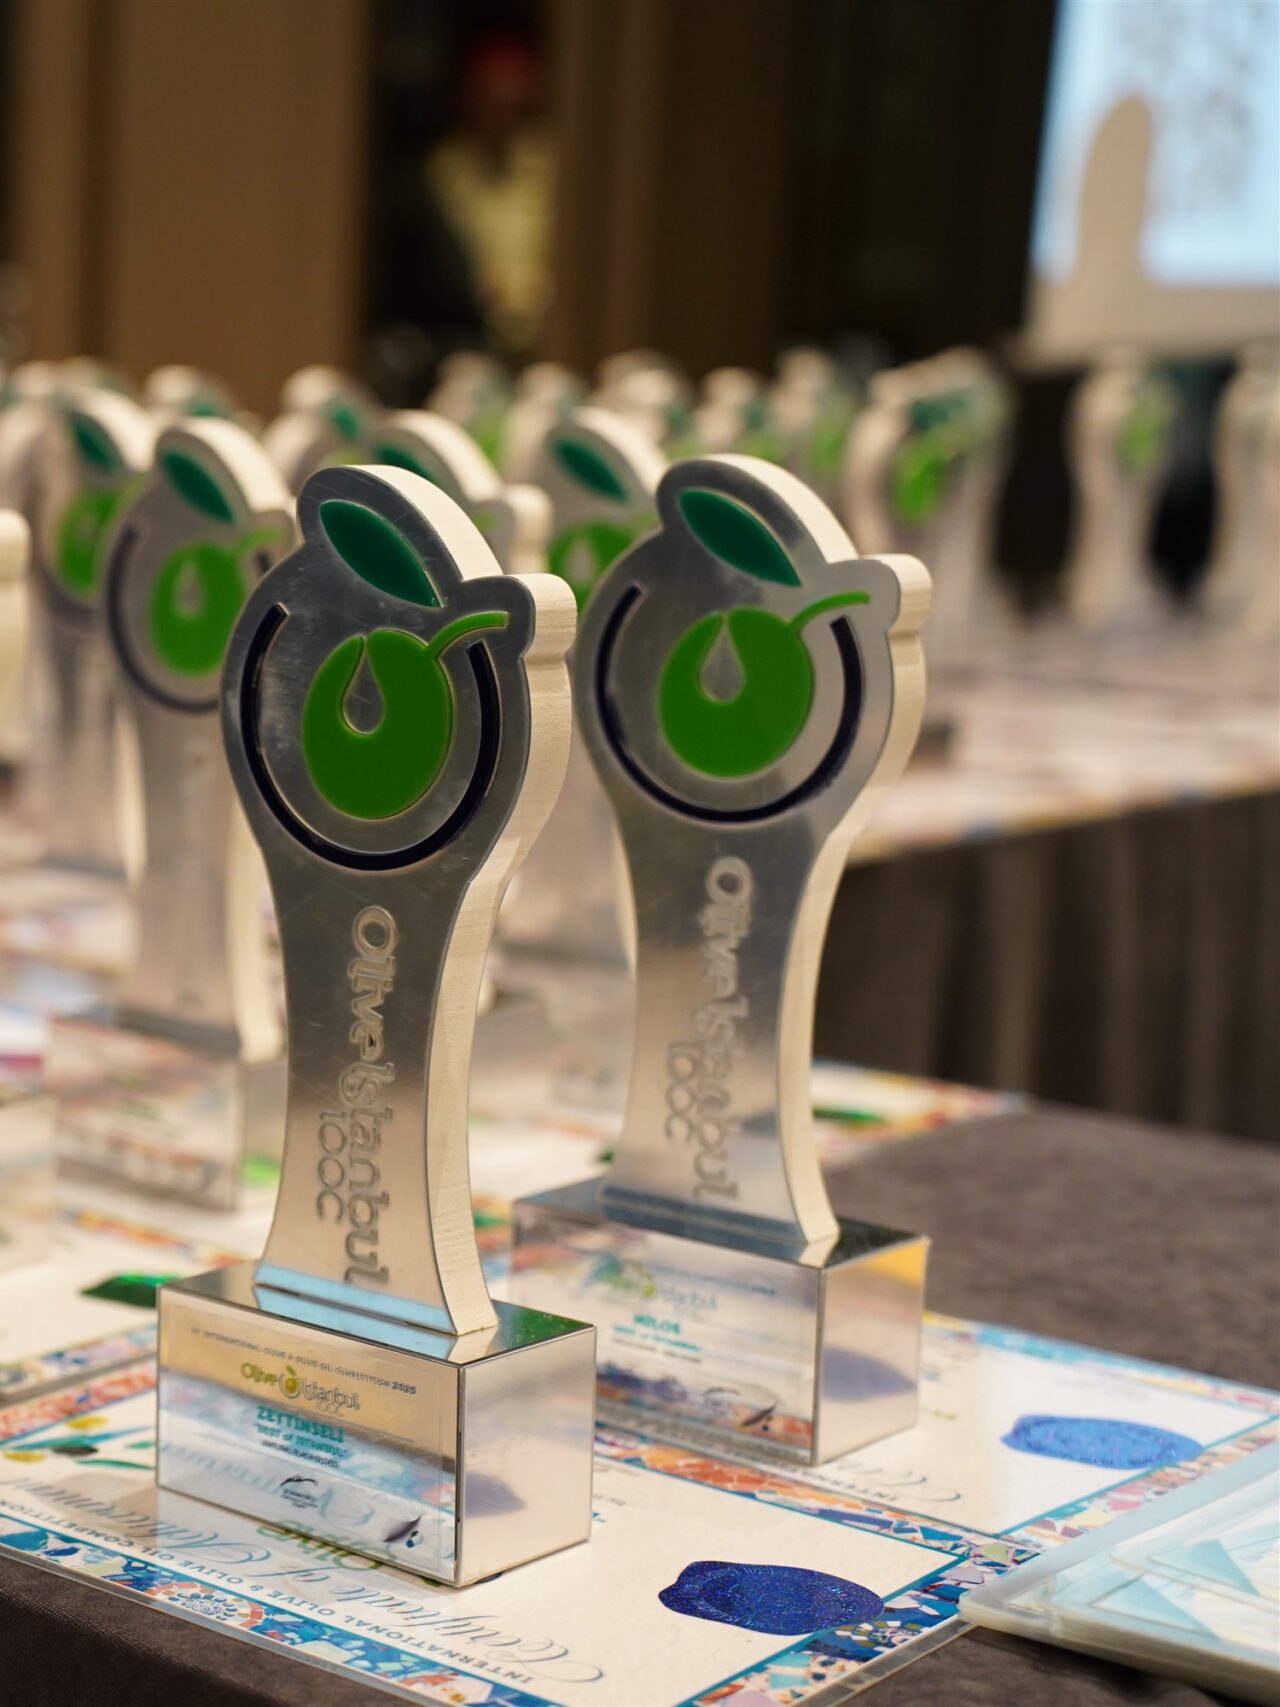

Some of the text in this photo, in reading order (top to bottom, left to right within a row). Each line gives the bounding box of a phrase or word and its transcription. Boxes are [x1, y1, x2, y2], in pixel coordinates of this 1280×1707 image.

[299, 1375, 361, 1411] Istanbul
[391, 1380, 417, 1395] 2025
[141, 1544, 176, 1563] OIL
[178, 1559, 244, 1586] OLIVE
[243, 1566, 330, 1584] of
[249, 1582, 265, 1593] &
[267, 1588, 337, 1617] OLIVE
[328, 1585, 603, 1683] Certificate
[344, 1614, 534, 1685] INTERNATIONAL
